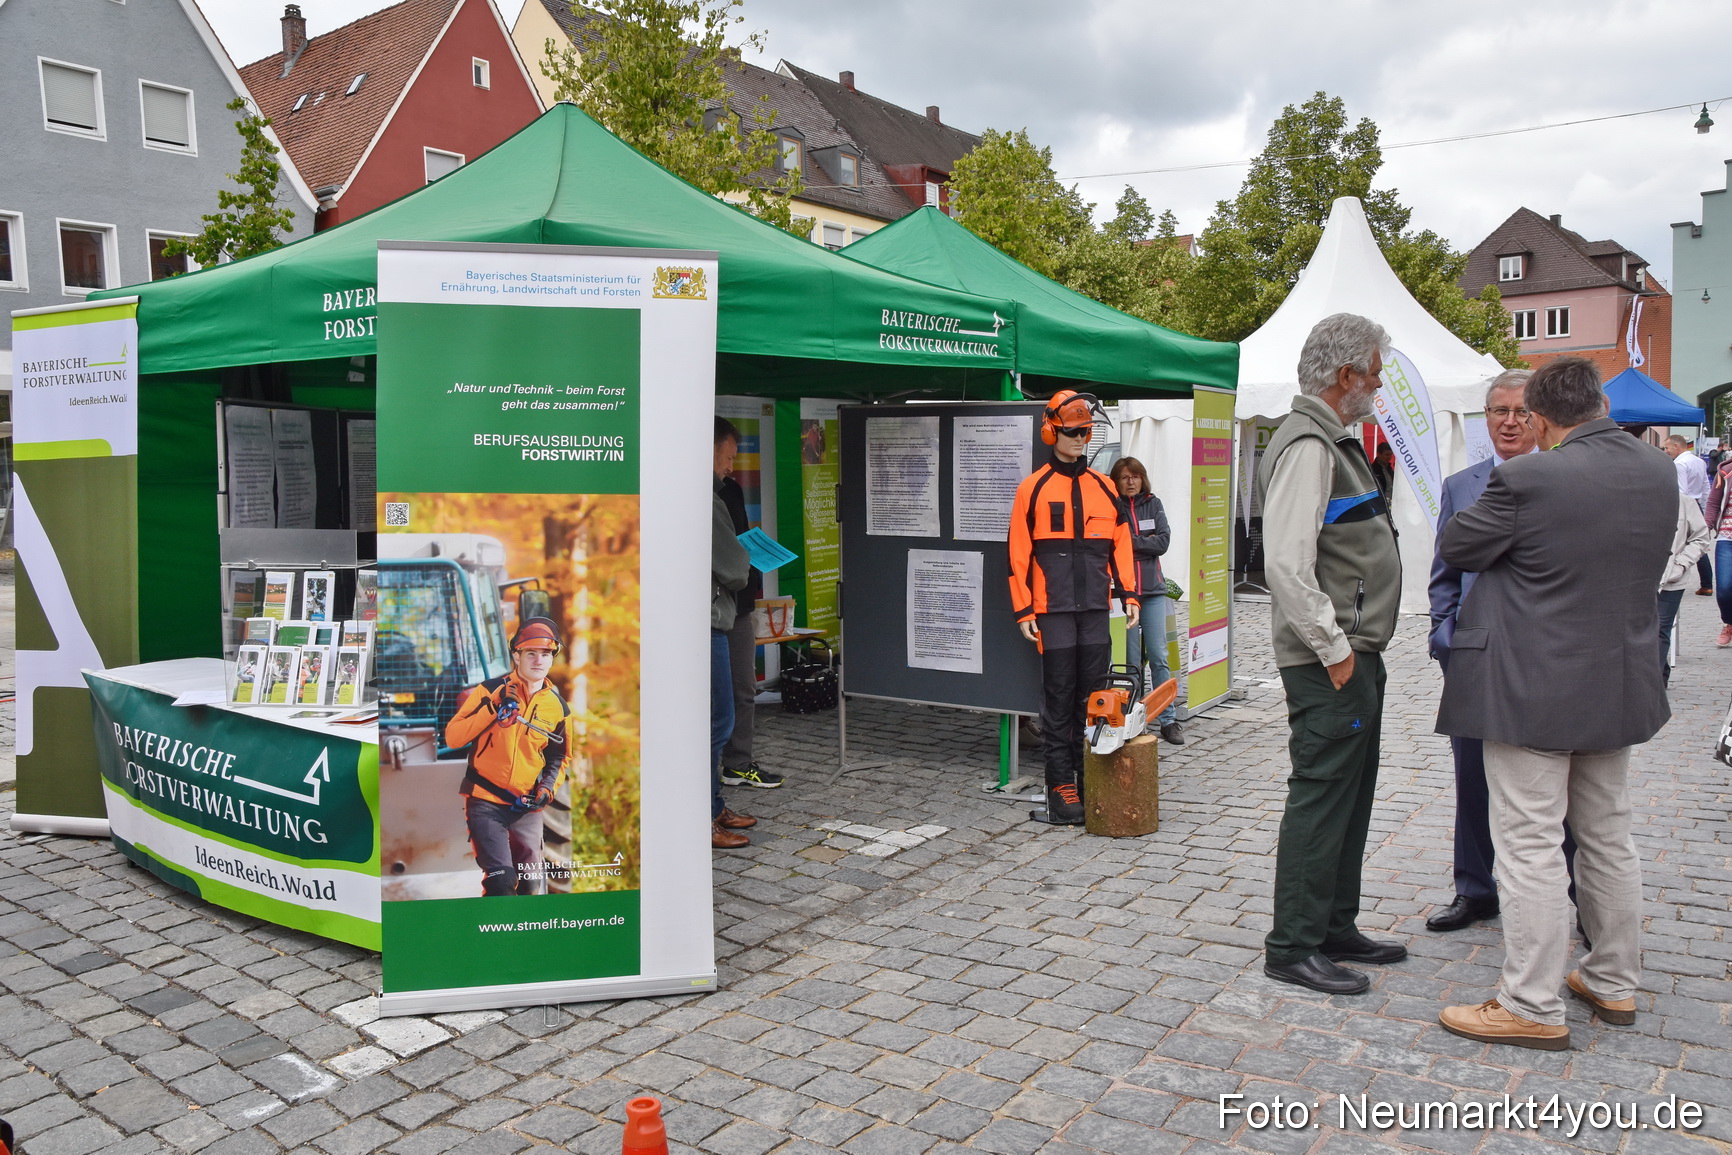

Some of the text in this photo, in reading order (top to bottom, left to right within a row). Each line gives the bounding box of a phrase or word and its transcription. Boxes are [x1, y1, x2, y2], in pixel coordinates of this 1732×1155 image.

[466, 270, 641, 285] Bayerisches Staatsministerium für
[441, 281, 641, 297] Ernährung, Landwirtschaft und Forsten
[323, 286, 377, 312] BAYER
[323, 315, 378, 341] FORST
[881, 308, 961, 334] BAYERISCHE
[879, 333, 999, 357] FORSTVERWALTUNG
[22, 357, 89, 374] BAYERISCHE
[489, 383, 511, 395] und
[512, 383, 554, 396] Technik
[566, 385, 594, 396] beim
[597, 385, 626, 397] Forst
[501, 399, 528, 412] geht
[530, 399, 550, 411] das
[473, 433, 624, 449] BERUFSAUSBILDUNG
[521, 449, 625, 463] FORSTWIRT/IN
[113, 721, 237, 781] BAYERISCHE
[194, 845, 338, 901] IdeenReich.Wald
[517, 859, 584, 871] BAYERISCHE
[518, 868, 621, 881] FORSTVERWALTUNG
[478, 914, 626, 934] www.stmelf.bayern.de
